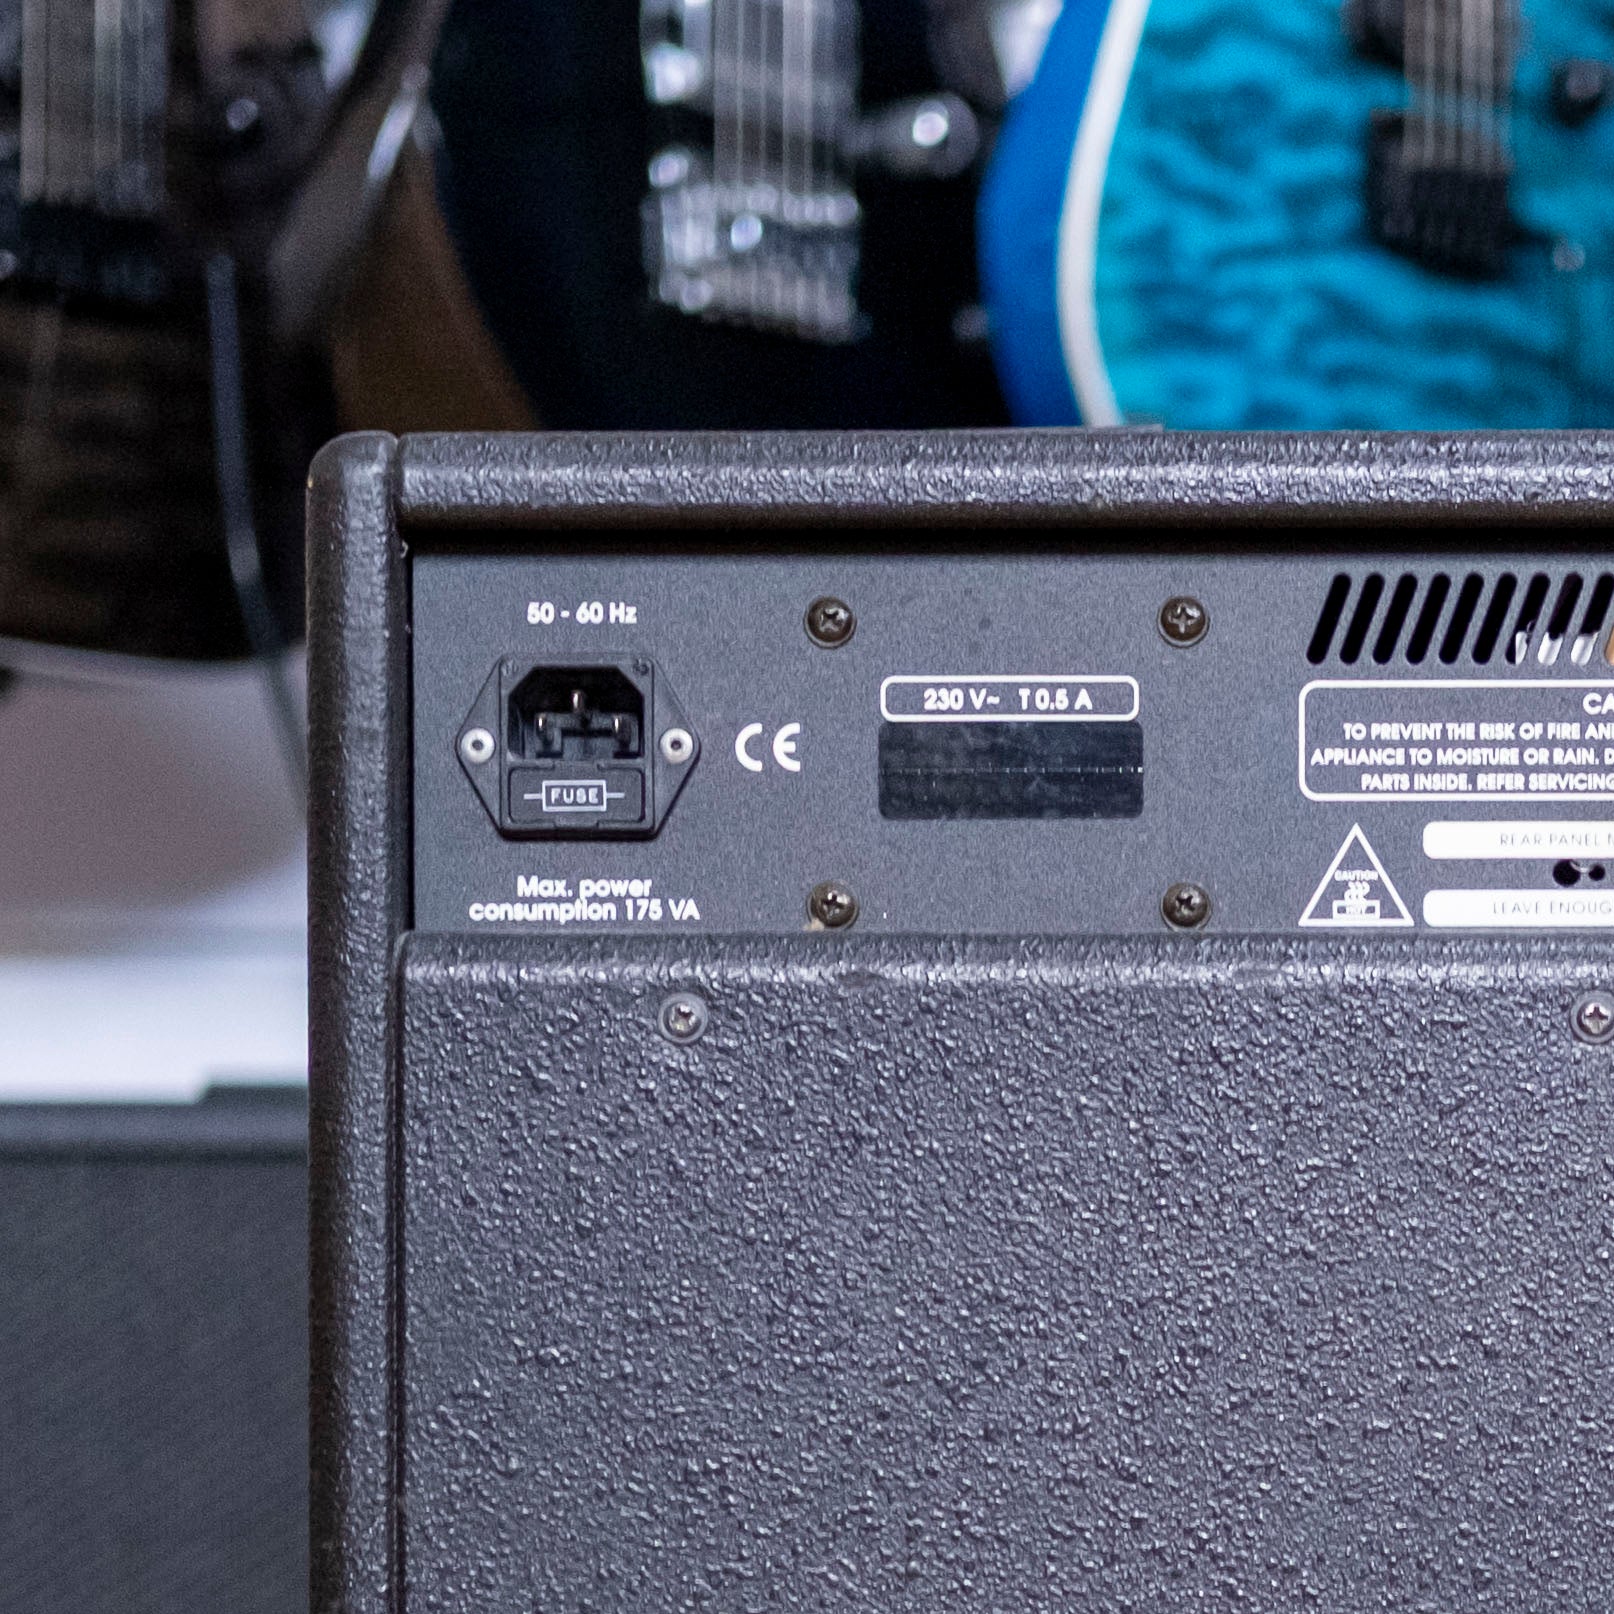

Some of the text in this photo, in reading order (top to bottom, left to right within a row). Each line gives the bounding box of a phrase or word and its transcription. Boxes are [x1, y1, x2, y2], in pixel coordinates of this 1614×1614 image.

[527, 602, 554, 624] 50
[575, 602, 604, 624] 60
[609, 602, 638, 624] Hz
[924, 688, 964, 711] 230
[1018, 688, 1031, 711] T
[1034, 688, 1069, 711] 0.5
[1074, 688, 1093, 711] A
[1343, 722, 1367, 740] TO
[1370, 722, 1443, 740] PREVENT
[1445, 722, 1476, 740] THE
[1479, 722, 1516, 740] RISK
[1518, 722, 1544, 740] OF
[1547, 722, 1581, 740] FIRE
[1310, 747, 1406, 765] APPLIANCE
[1408, 747, 1433, 765] TO
[1436, 747, 1520, 765] MOISTURE
[1523, 747, 1550, 765] OR
[1552, 747, 1600, 766] RAIN.
[1360, 772, 1411, 791] PARTS
[1413, 772, 1473, 791] INSIDE.
[1476, 772, 1526, 791] REFER
[550, 787, 600, 805] FUSE
[1499, 832, 1543, 847] REAR
[1549, 832, 1600, 847] PANEL
[516, 875, 653, 904] Max. power
[468, 900, 701, 925] consumption 175 VA
[1493, 900, 1540, 915] LEAVE
